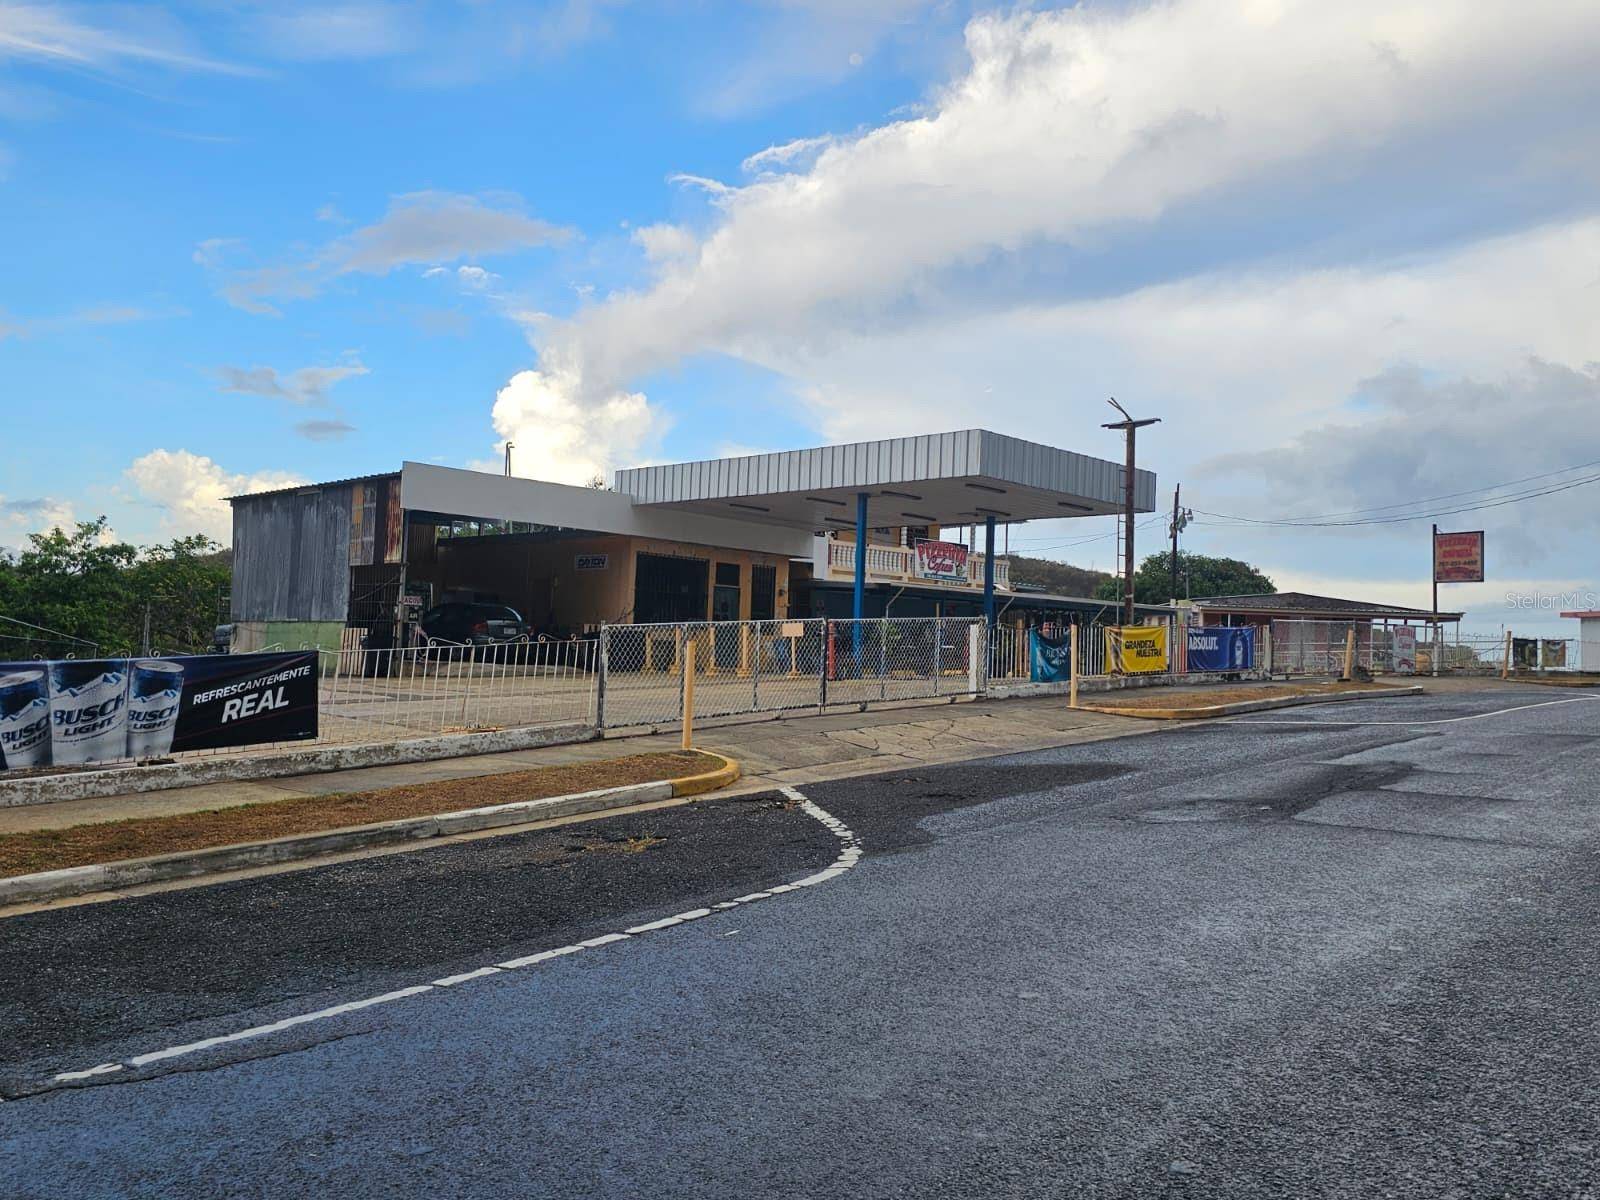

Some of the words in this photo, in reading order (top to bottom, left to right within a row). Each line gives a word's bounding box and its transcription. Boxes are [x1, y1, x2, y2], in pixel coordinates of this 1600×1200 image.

[1136, 648, 1162, 658] NUESTRA
[193, 665, 311, 705] REFRESCANTEMENTE
[128, 703, 179, 722] BUSCH
[221, 686, 290, 723] REAL
[64, 715, 116, 736] LIGHT
[133, 719, 170, 730] LIGHT
